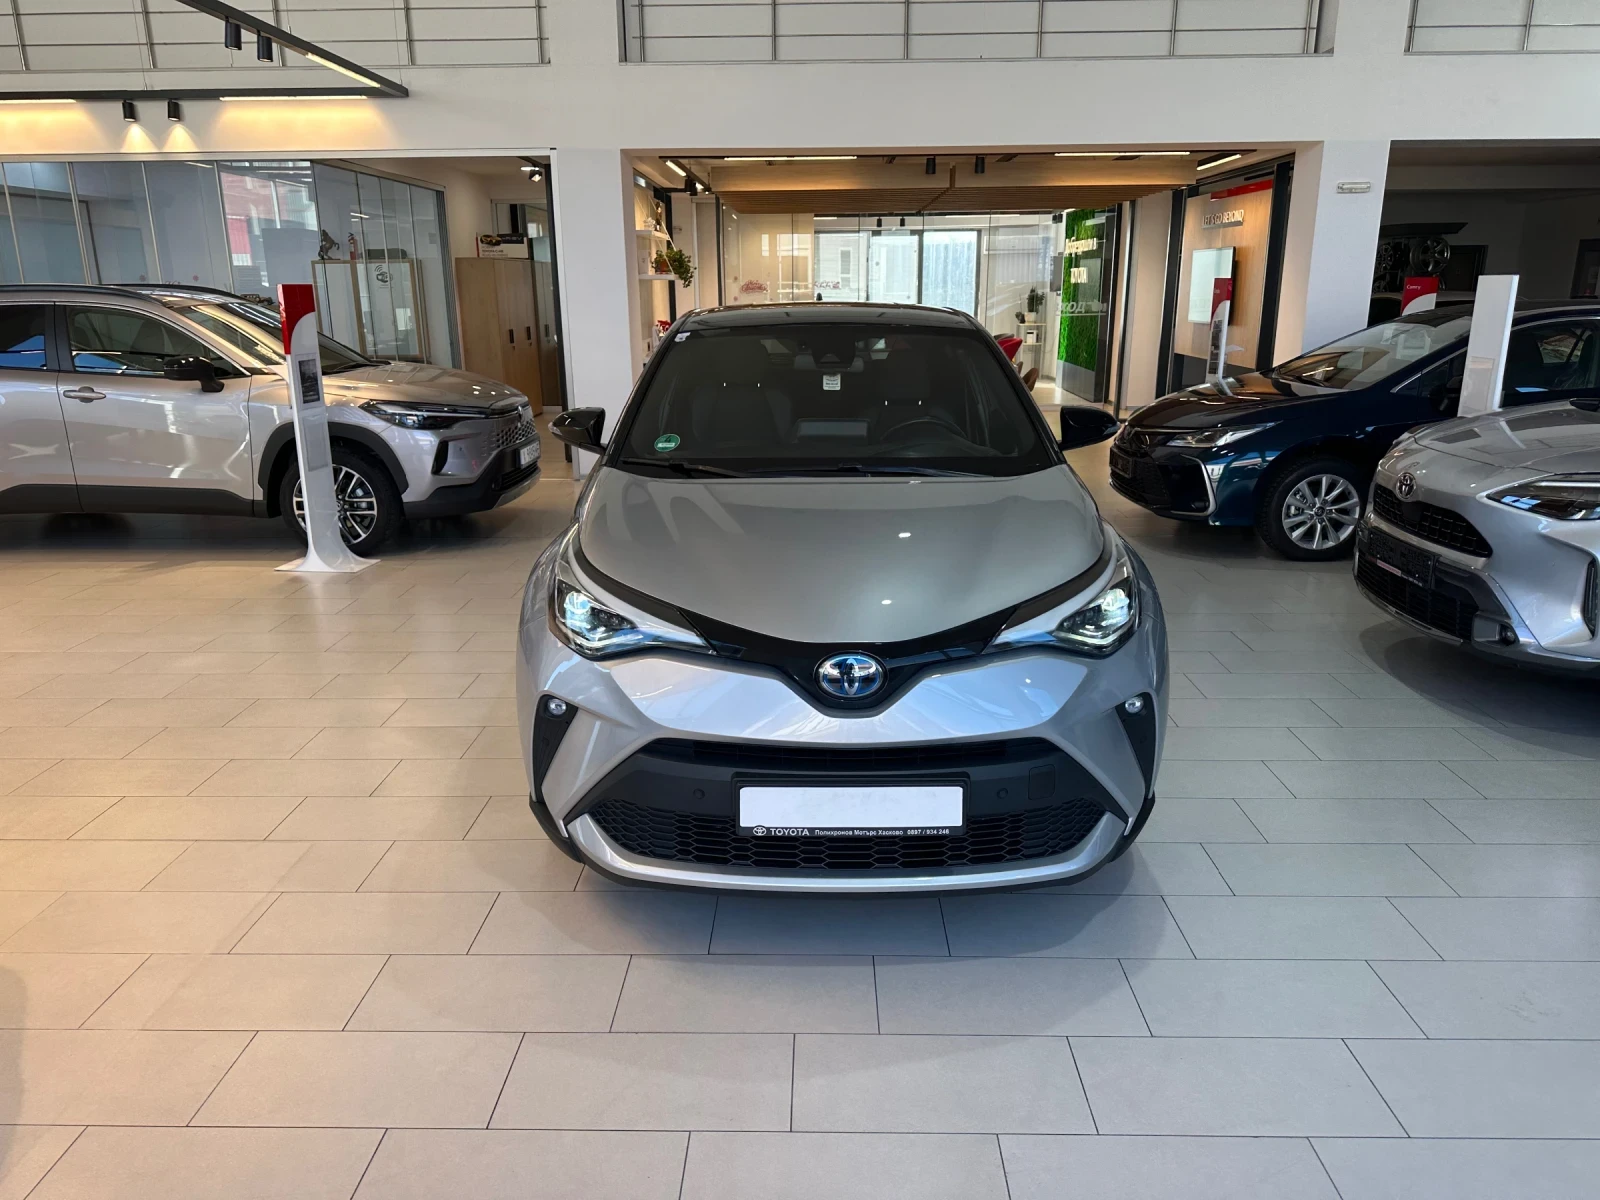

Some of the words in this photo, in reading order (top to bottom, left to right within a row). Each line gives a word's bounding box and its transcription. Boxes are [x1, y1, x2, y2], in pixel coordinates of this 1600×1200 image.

[1214, 213, 1222, 225] GO
[1222, 210, 1244, 223] BEYOND
[1406, 283, 1422, 291] Camry
[769, 828, 810, 836] TOYOTA
[815, 829, 853, 837] Полихронов
